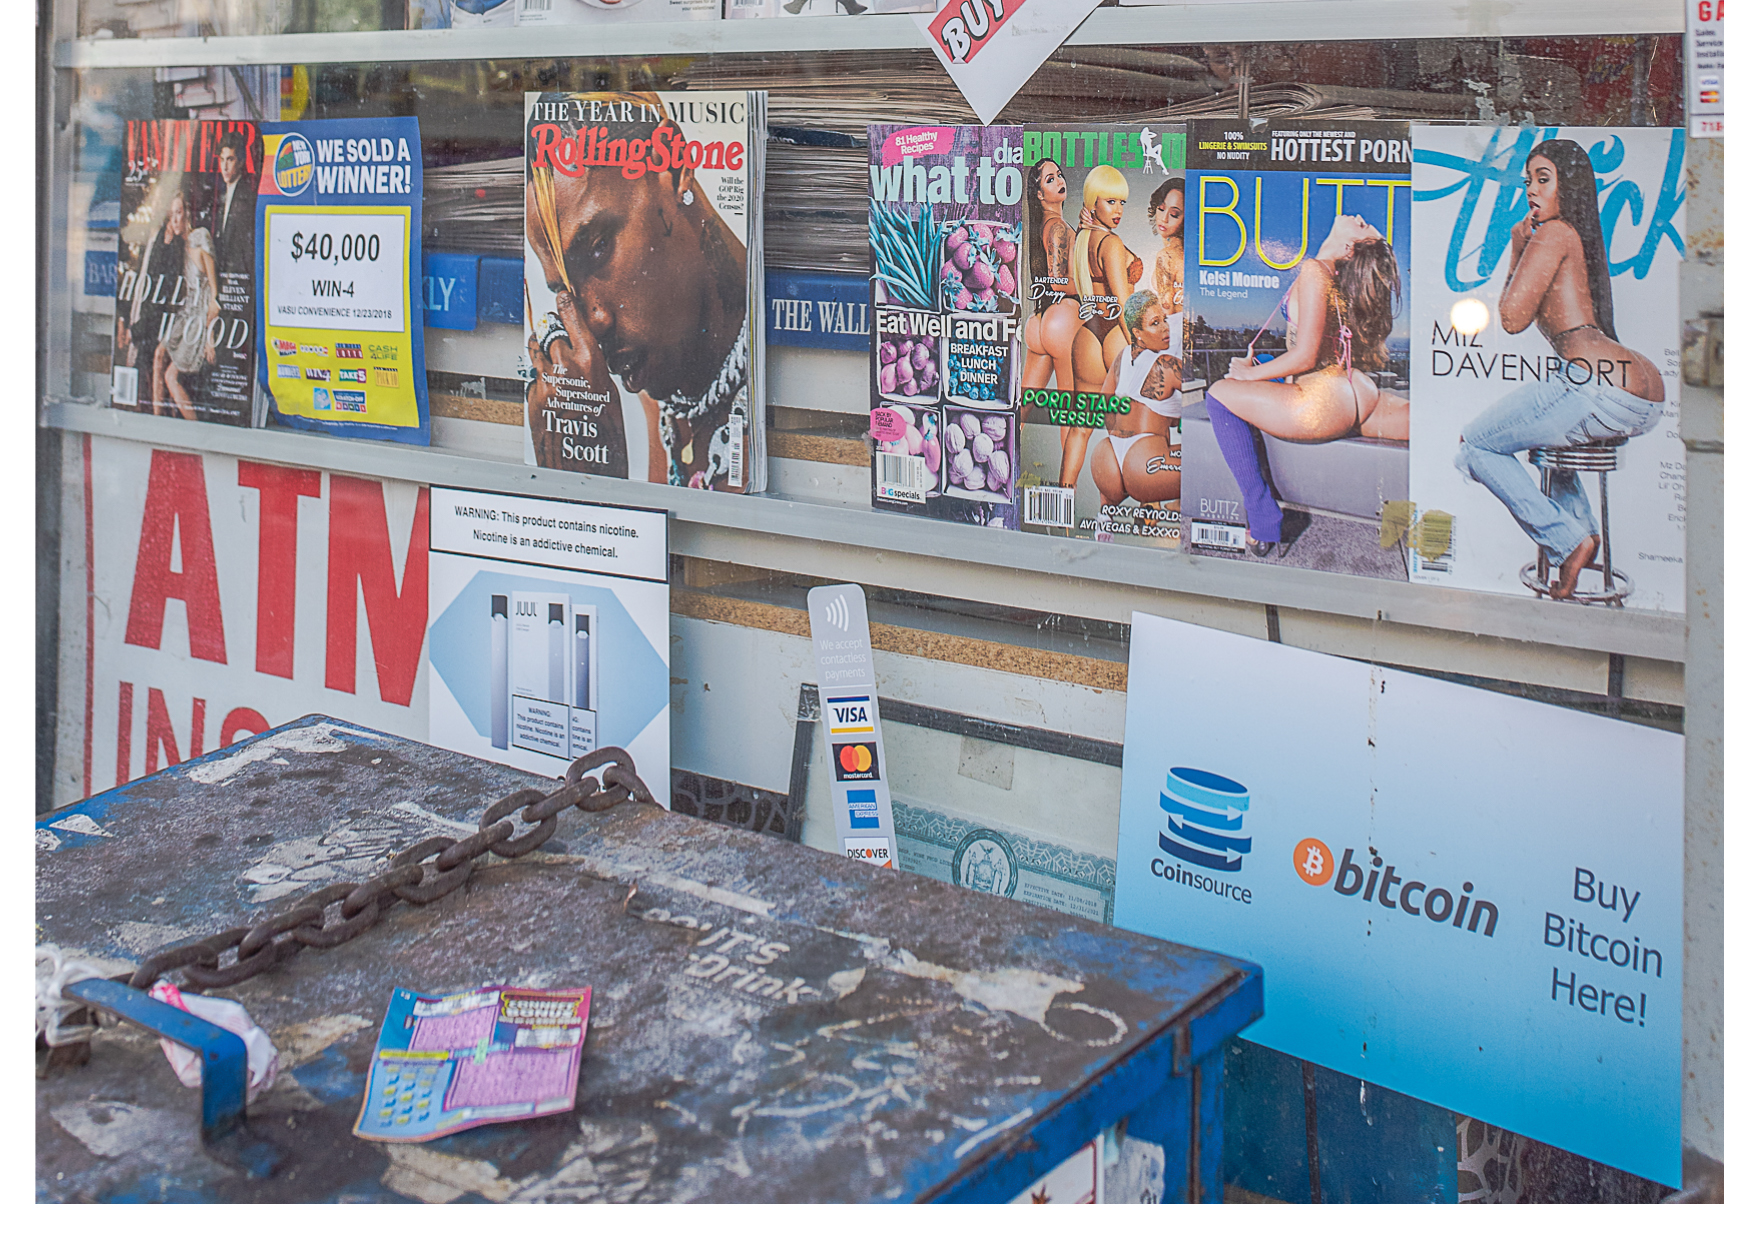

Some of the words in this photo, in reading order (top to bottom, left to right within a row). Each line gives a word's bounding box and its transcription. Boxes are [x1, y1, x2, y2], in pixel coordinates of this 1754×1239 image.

[533, 101, 569, 124] THE
[574, 101, 635, 123] YEAR
[640, 101, 662, 124] IN
[669, 100, 745, 125] MUSIC
[317, 139, 344, 162] WE
[347, 139, 394, 162] SOLD
[398, 137, 411, 161] A
[317, 165, 412, 194] WINNER!
[291, 231, 381, 266] $40,000
[312, 279, 355, 298] WIN-4
[278, 305, 296, 316] VASU
[298, 307, 350, 318] CONVENIENCE
[353, 308, 392, 319] 12/23/2018
[772, 299, 811, 333] THE
[817, 297, 870, 335] WALL
[951, 342, 1008, 357] BREAKFAST
[960, 371, 998, 385] DINNER
[961, 358, 996, 371] LUNCH
[1431, 351, 1632, 388] DAVENPORT
[1024, 389, 1072, 409] PORN
[1076, 396, 1131, 414] STARS
[1049, 408, 1105, 427] VERSUS
[455, 505, 499, 522] WARNING:
[502, 511, 520, 524] This
[522, 516, 556, 529] product
[559, 521, 597, 533] contains
[599, 525, 639, 538] nicotine.
[473, 529, 508, 544] Nicotine
[510, 535, 517, 545] is
[520, 537, 530, 547] an
[532, 539, 572, 552] addictive
[575, 543, 618, 558] chemical.
[124, 448, 430, 708] ATM
[833, 707, 868, 724] VISA
[848, 847, 889, 860] DISCOVER
[1150, 858, 1253, 906] Coinsource
[1334, 846, 1500, 938] bitcoin
[1573, 865, 1641, 921] Buy
[1543, 913, 1664, 979] Bitcoin
[1551, 968, 1647, 1029] Here!
